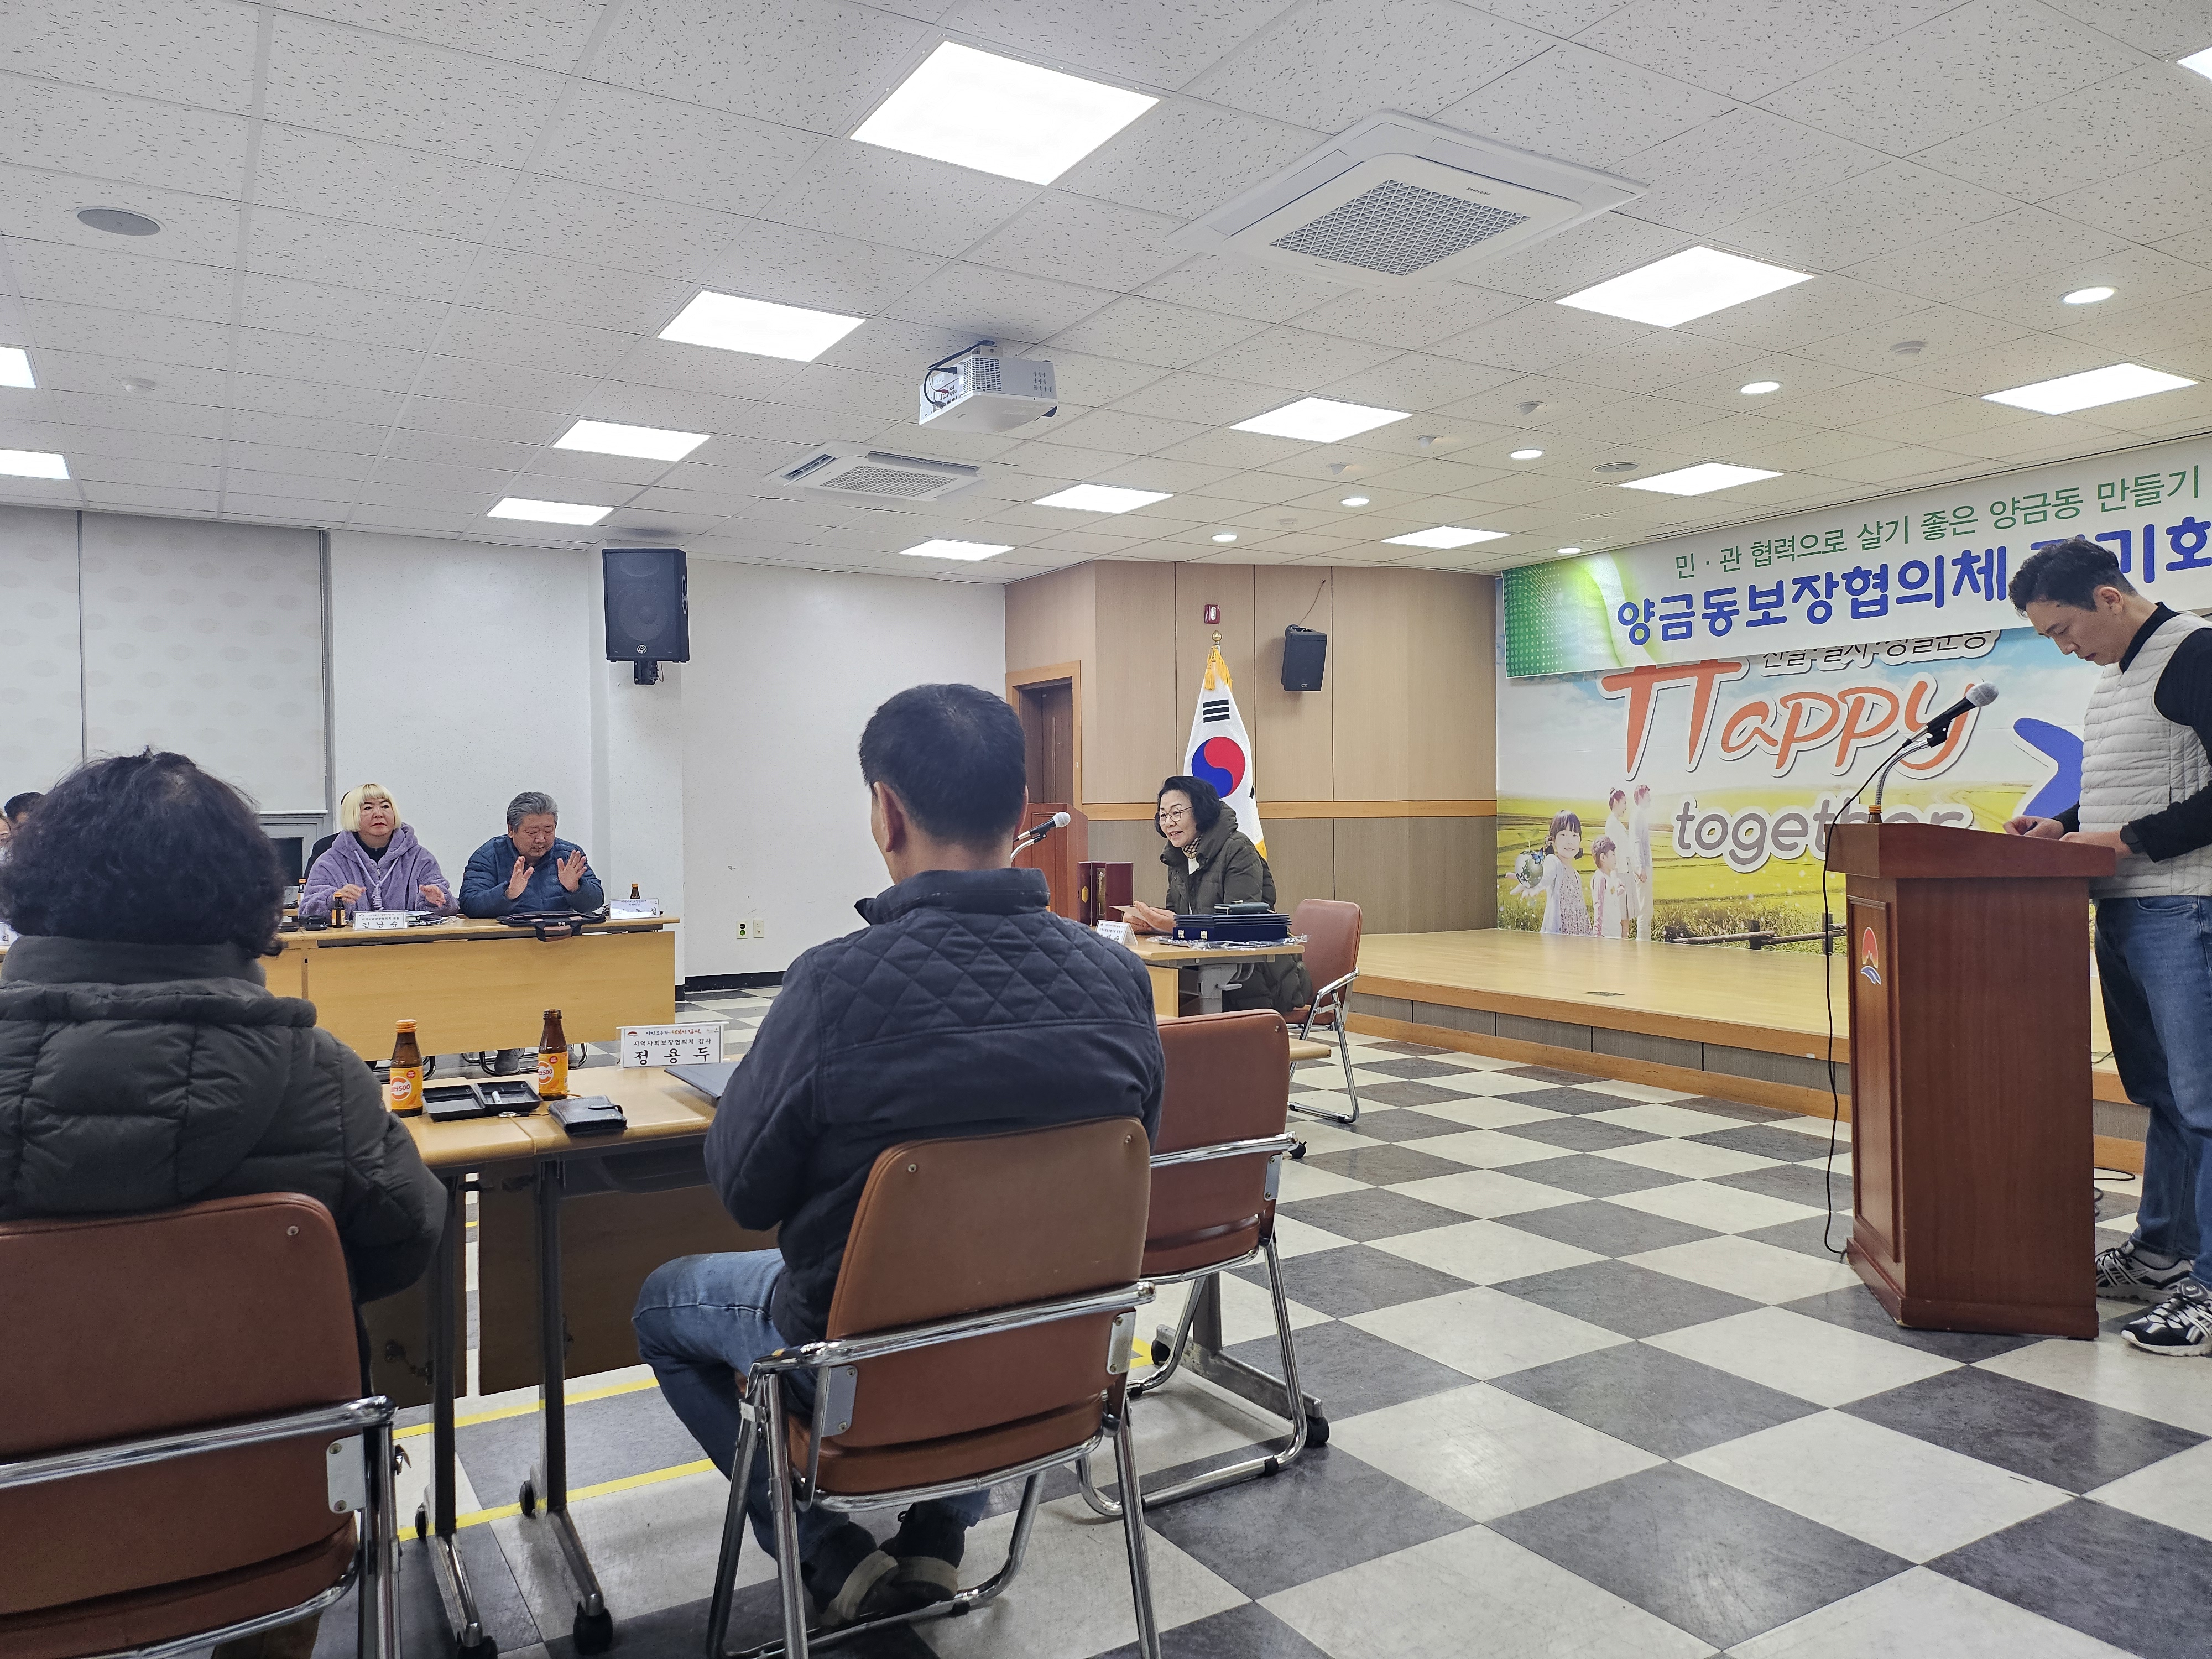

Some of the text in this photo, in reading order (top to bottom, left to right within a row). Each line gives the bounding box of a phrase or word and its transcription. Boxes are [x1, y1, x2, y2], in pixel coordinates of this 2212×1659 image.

[1750, 529, 1848, 568] 협력으로
[1856, 515, 1909, 551] 살기
[1920, 505, 1979, 541] 좋은
[1989, 487, 2084, 530] 양금동
[2098, 465, 2199, 513] 만들기
[1617, 545, 2007, 646] 양금동보장협의체
[633, 1038, 694, 1047] 지역사회보장협의체
